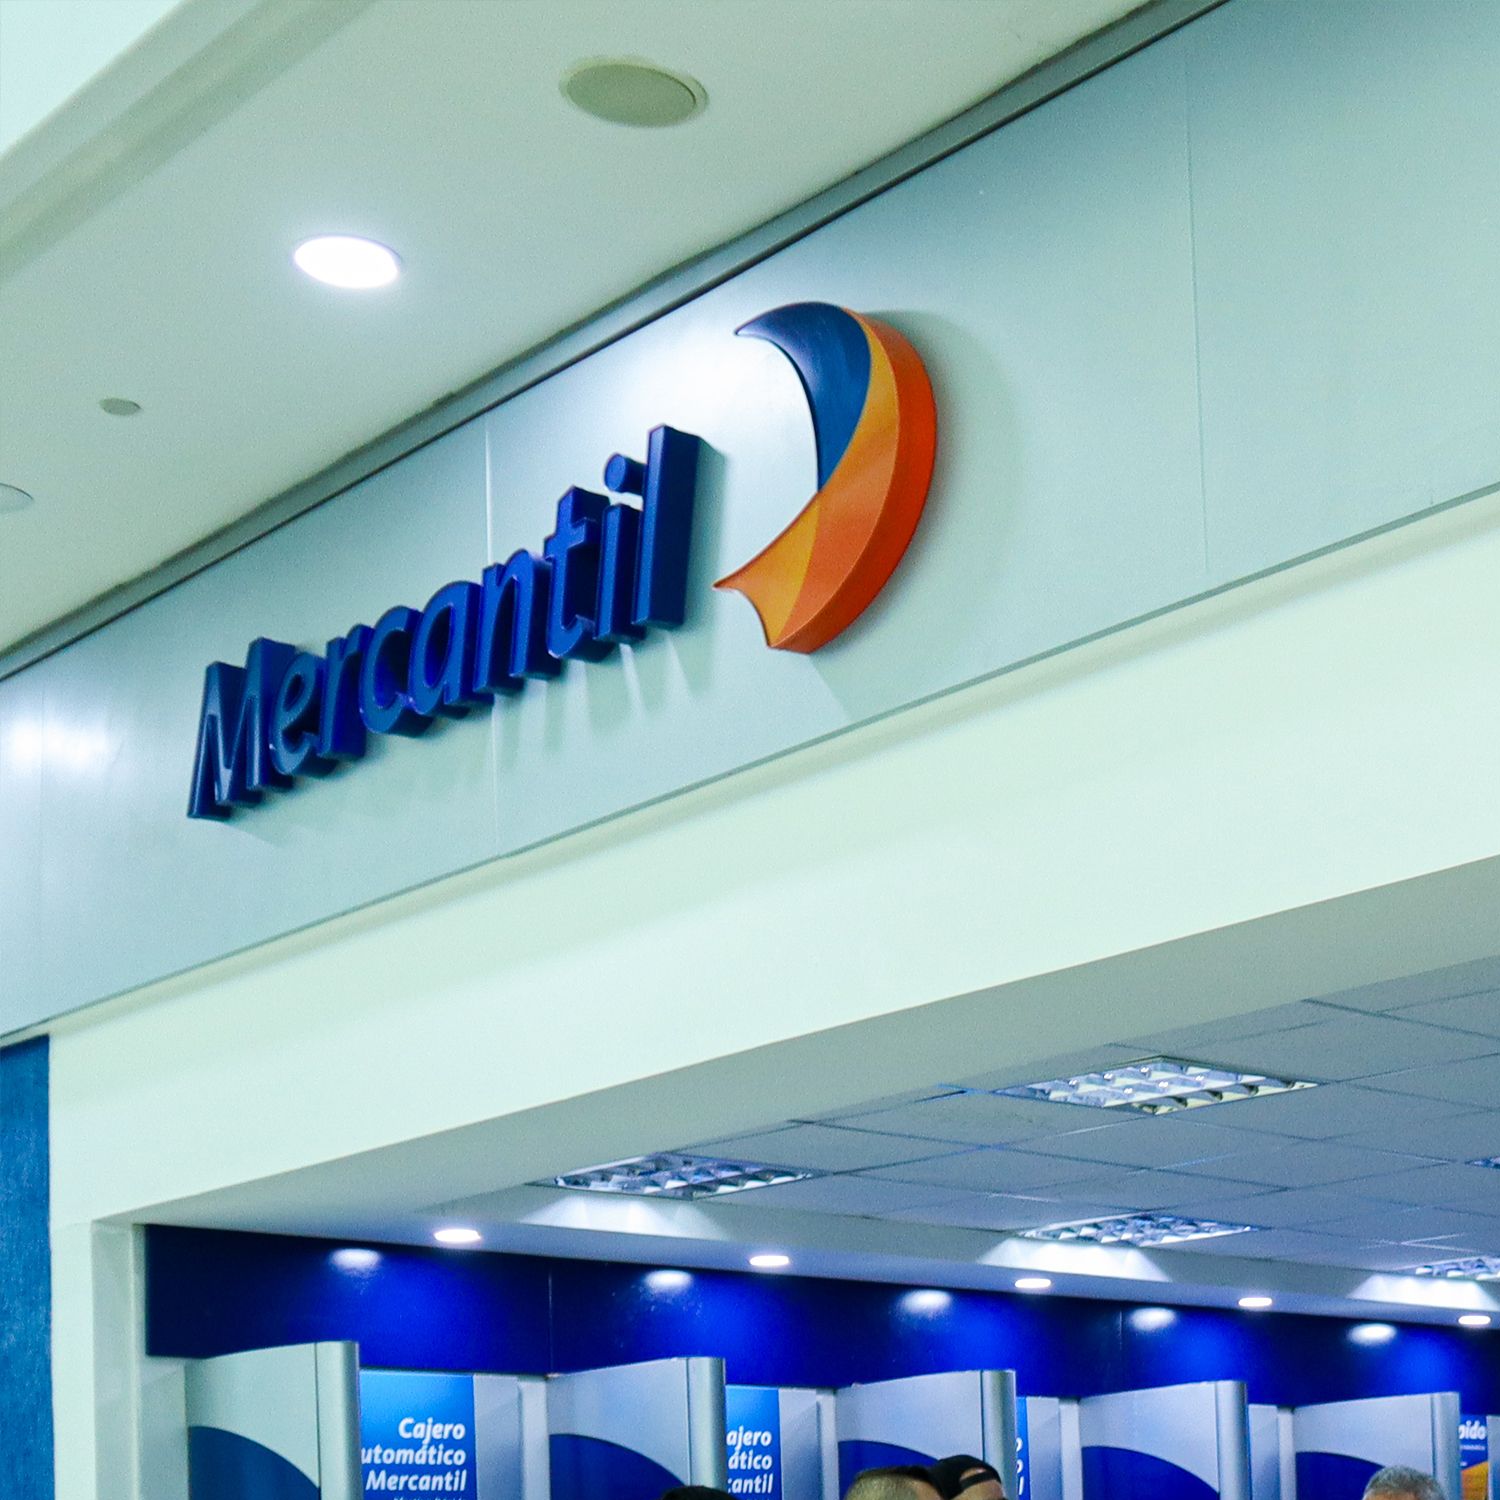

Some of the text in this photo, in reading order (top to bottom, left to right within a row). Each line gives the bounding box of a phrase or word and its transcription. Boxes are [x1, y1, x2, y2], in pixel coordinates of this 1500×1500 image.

[187, 424, 702, 820] Mercantil
[398, 1416, 466, 1444] Cajero
[726, 1425, 772, 1451] ajero
[361, 1443, 467, 1466] utomático
[728, 1449, 773, 1470] ático
[365, 1469, 468, 1491] Mercantil
